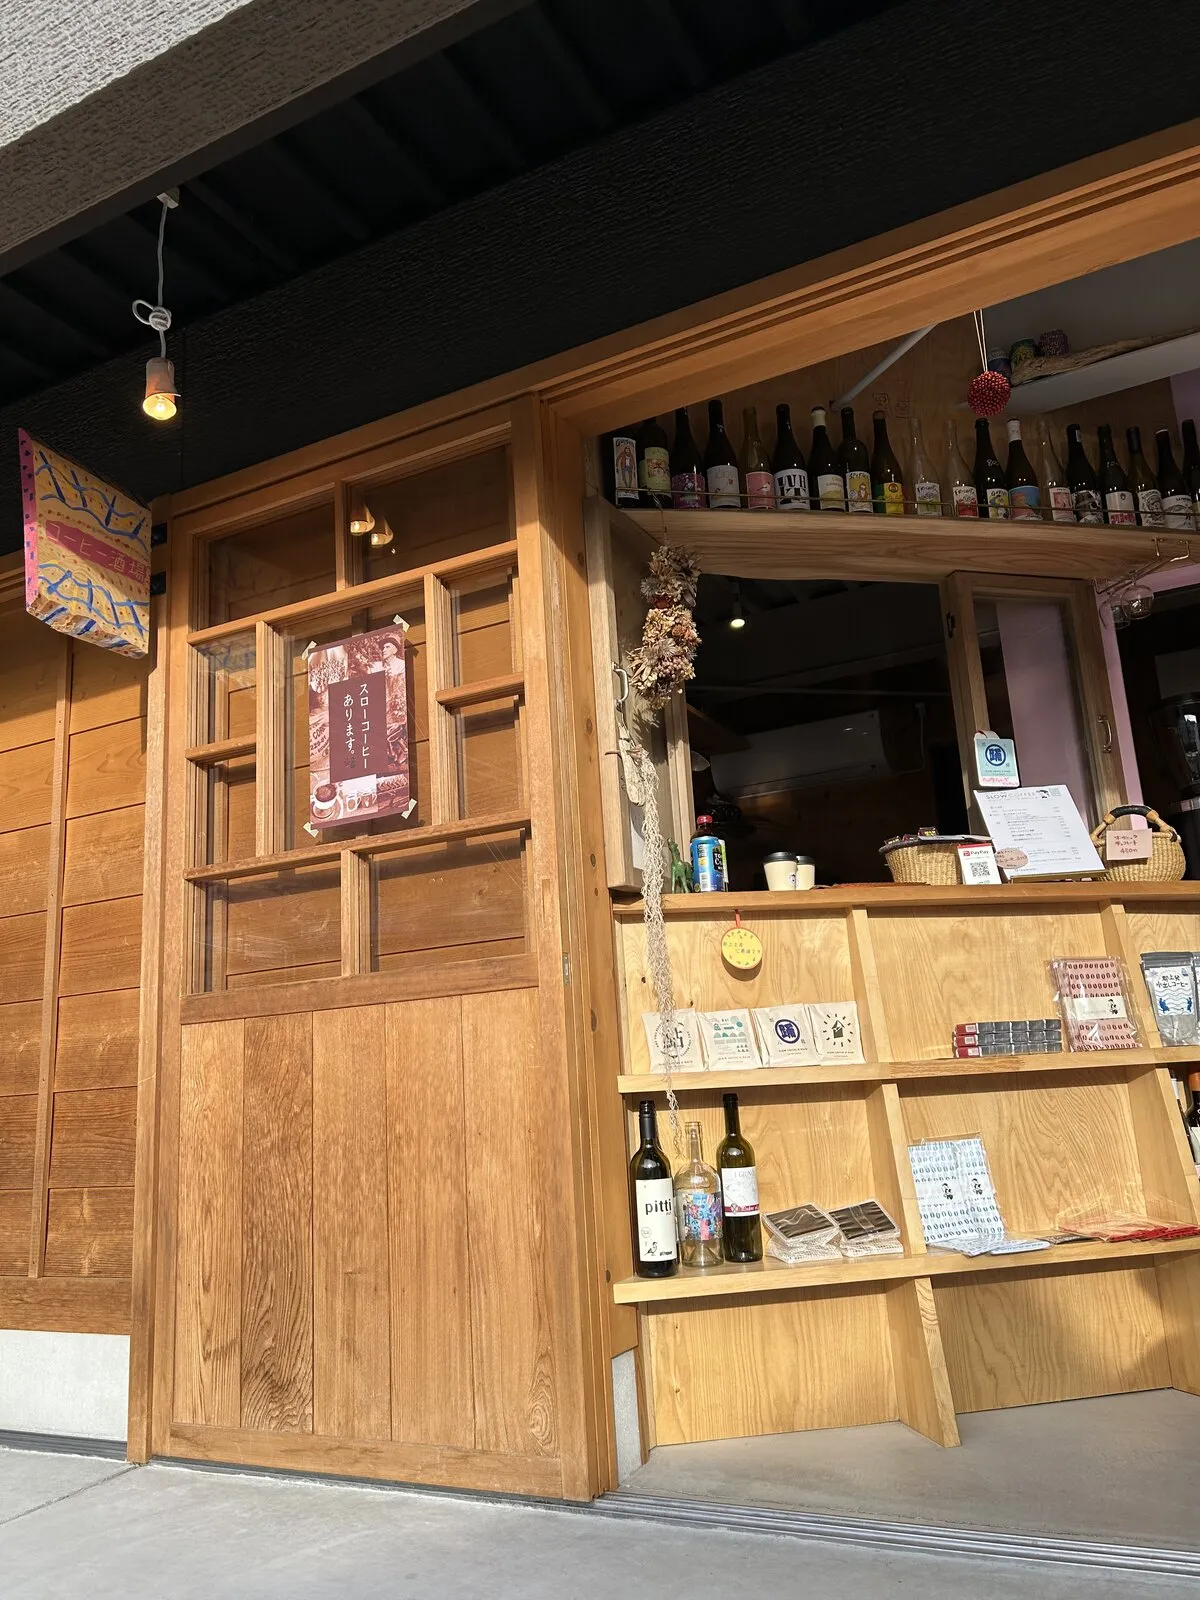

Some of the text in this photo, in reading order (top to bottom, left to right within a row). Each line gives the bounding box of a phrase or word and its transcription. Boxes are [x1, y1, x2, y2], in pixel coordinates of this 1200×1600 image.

[48, 523, 147, 581] コーヒー酒場
[343, 693, 356, 755] あります。
[359, 683, 370, 769] スローコーヒー
[645, 1198, 672, 1215] pitti
